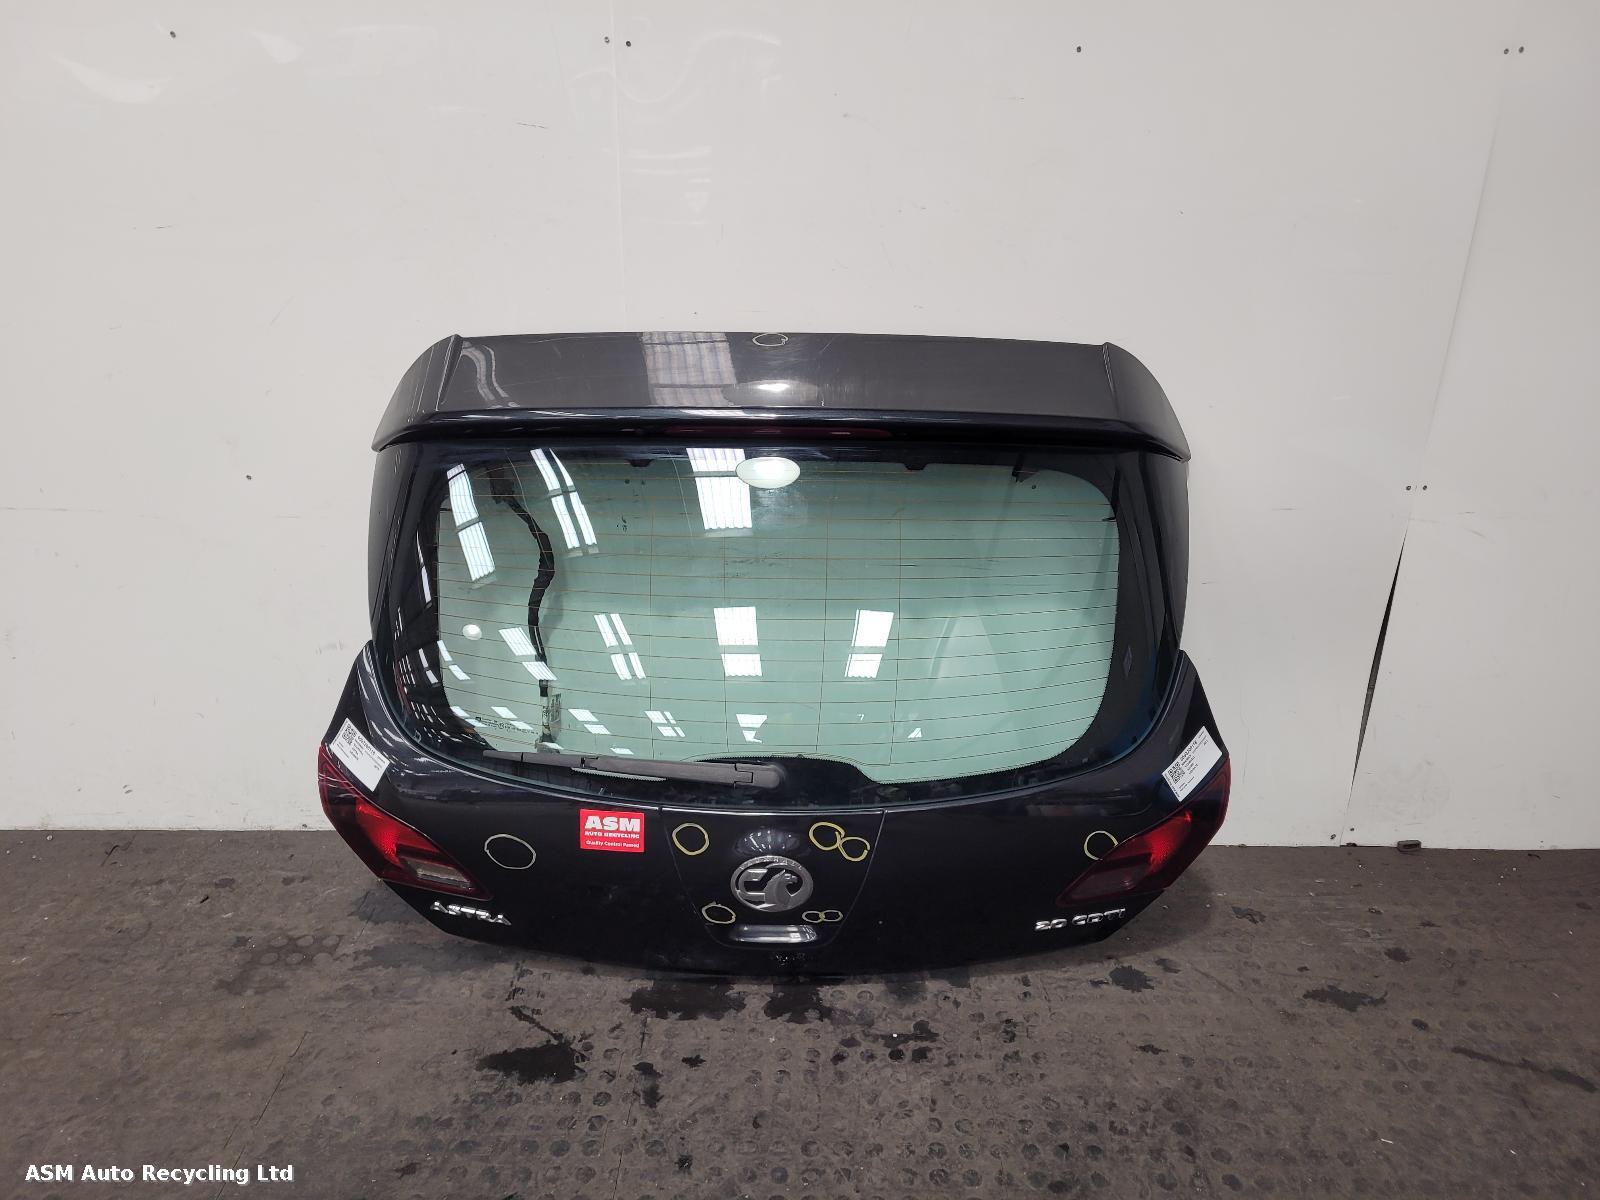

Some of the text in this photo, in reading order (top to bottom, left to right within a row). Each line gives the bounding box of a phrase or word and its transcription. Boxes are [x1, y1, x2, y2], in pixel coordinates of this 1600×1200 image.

[584, 815, 641, 832] ASM
[586, 839, 603, 847] Quality
[430, 901, 512, 925] ASTRA
